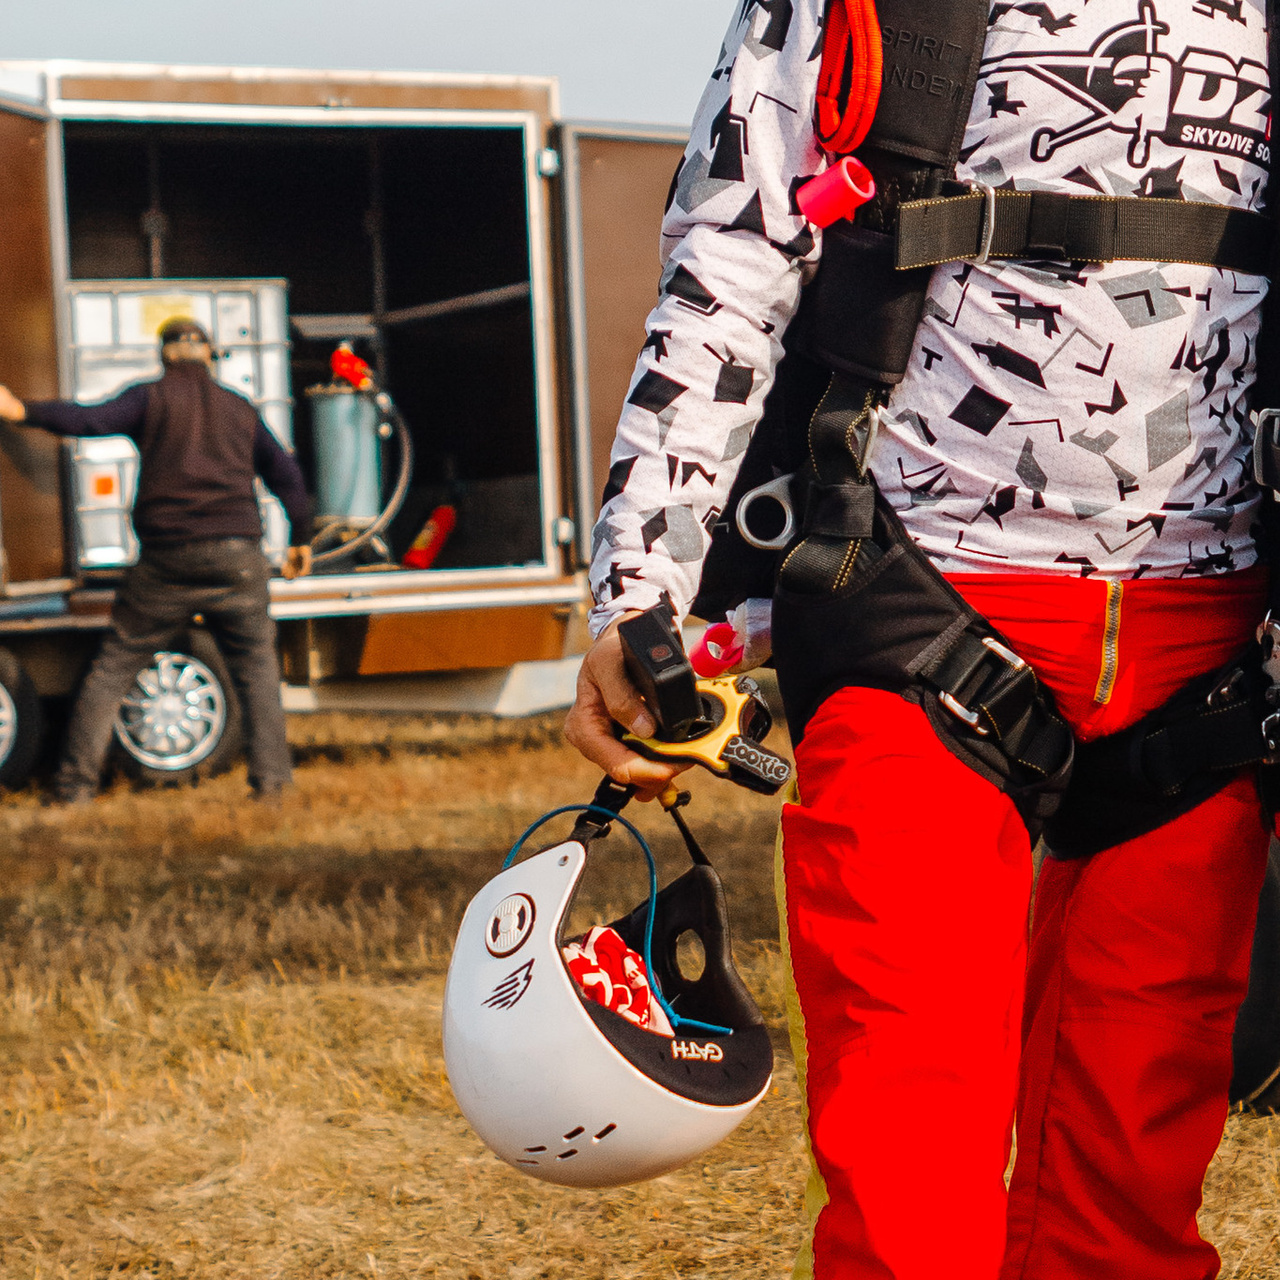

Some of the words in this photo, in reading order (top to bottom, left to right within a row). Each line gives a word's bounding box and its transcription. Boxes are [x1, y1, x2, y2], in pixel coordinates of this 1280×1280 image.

[881, 25, 962, 64] SPIRIT
[1180, 125, 1255, 155] SKYDIVE
[671, 1040, 724, 1063] GATH
